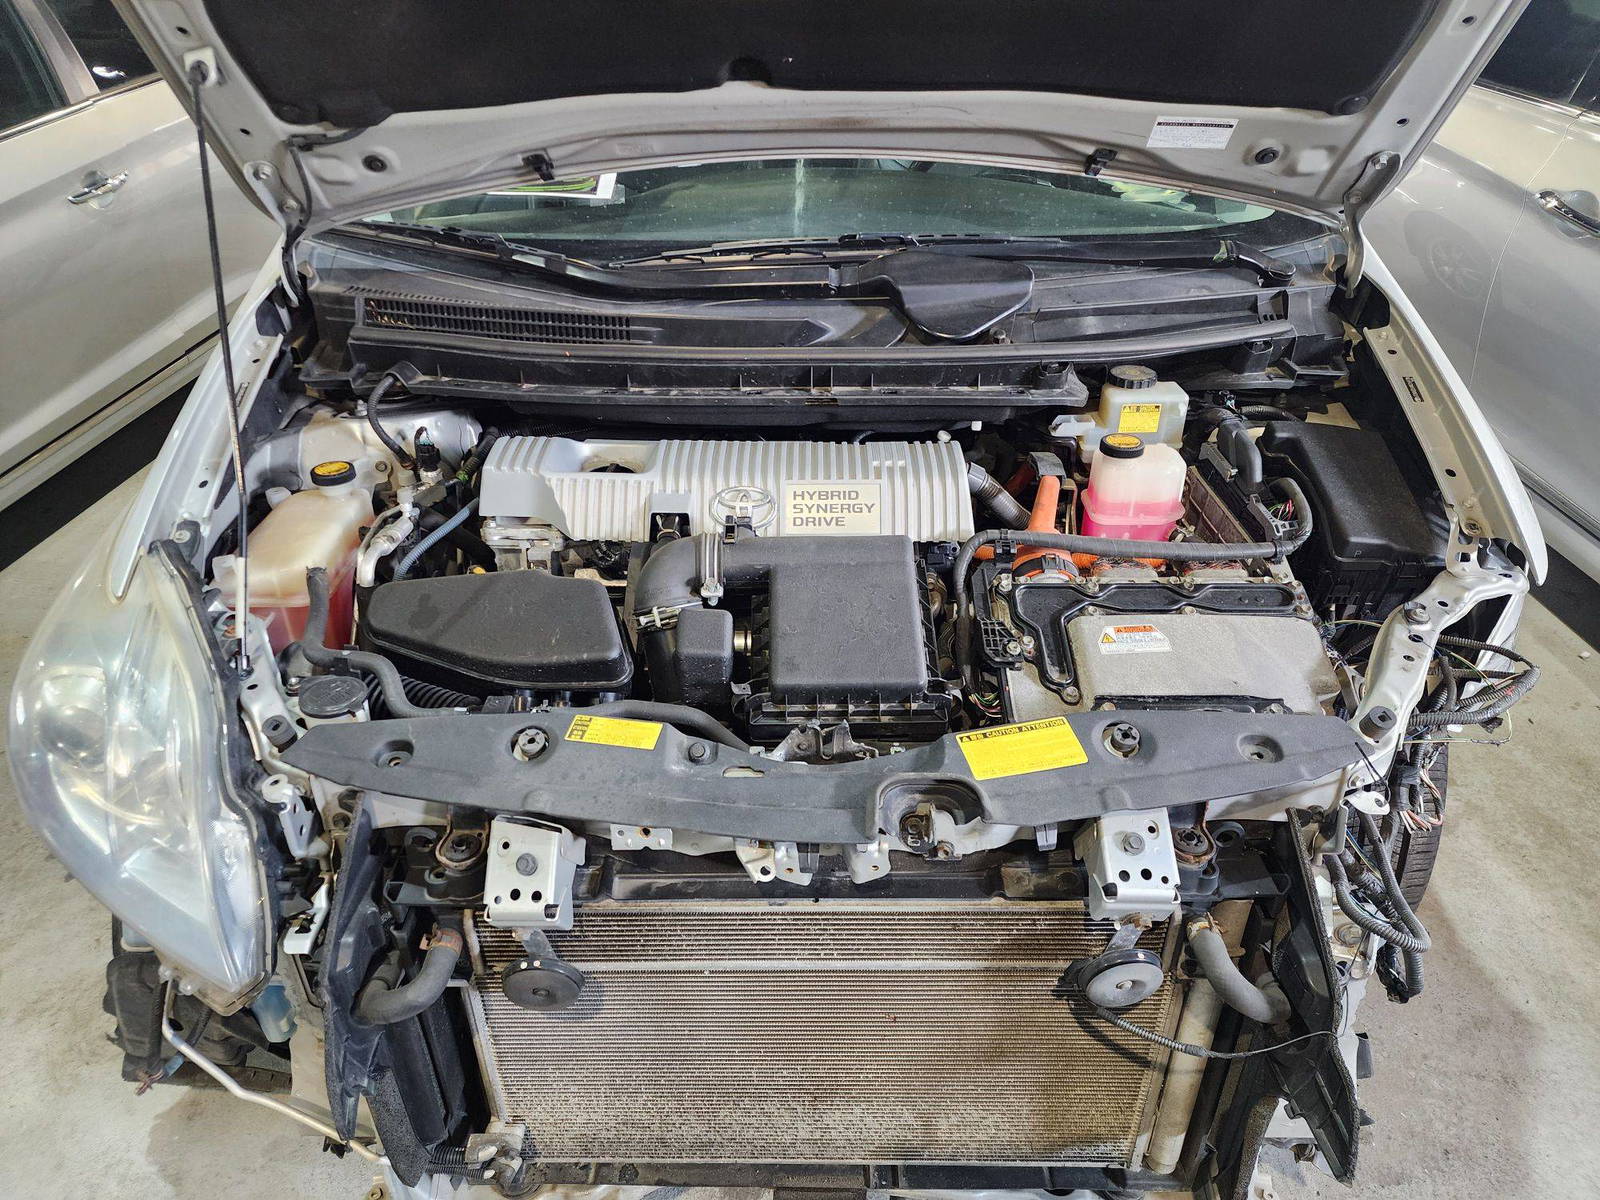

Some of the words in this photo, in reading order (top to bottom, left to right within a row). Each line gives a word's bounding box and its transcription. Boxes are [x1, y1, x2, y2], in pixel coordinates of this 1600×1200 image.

[793, 490, 859, 501] HYBRID
[793, 503, 875, 514] SYNERGY
[793, 516, 846, 527] DRIVE
[986, 727, 1019, 737] CAUTION
[1021, 719, 1065, 731] ATTENTION
